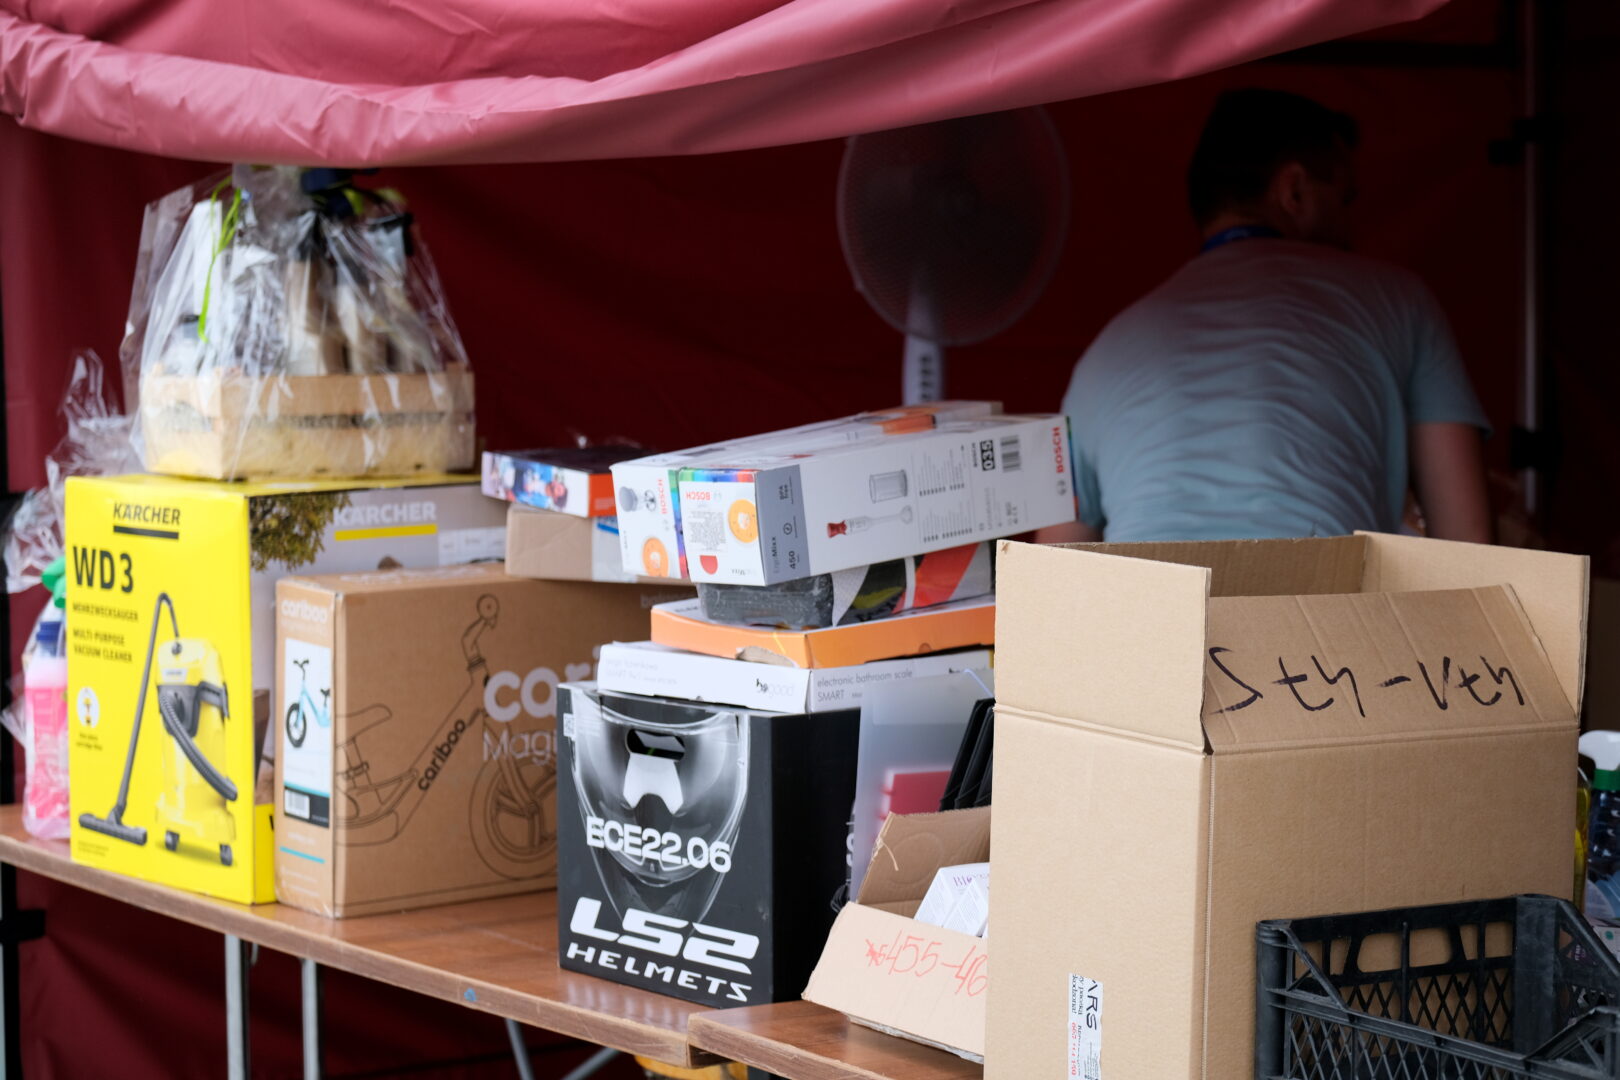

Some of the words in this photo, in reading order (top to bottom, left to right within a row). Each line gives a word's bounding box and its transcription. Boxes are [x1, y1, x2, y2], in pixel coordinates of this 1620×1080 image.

[1052, 426, 1065, 474] BOSCH
[657, 479, 668, 514] BOSCH
[686, 492, 711, 501] BOSCH
[788, 550, 796, 570] 450
[817, 675, 854, 688] electronic
[855, 671, 892, 684] bathroom
[893, 669, 913, 680] scale
[817, 689, 845, 702] SMART
[417, 718, 467, 792] cariboo
[586, 815, 732, 873] ECE22.06
[570, 896, 760, 975] LS2
[566, 942, 753, 1003] HELMETS
